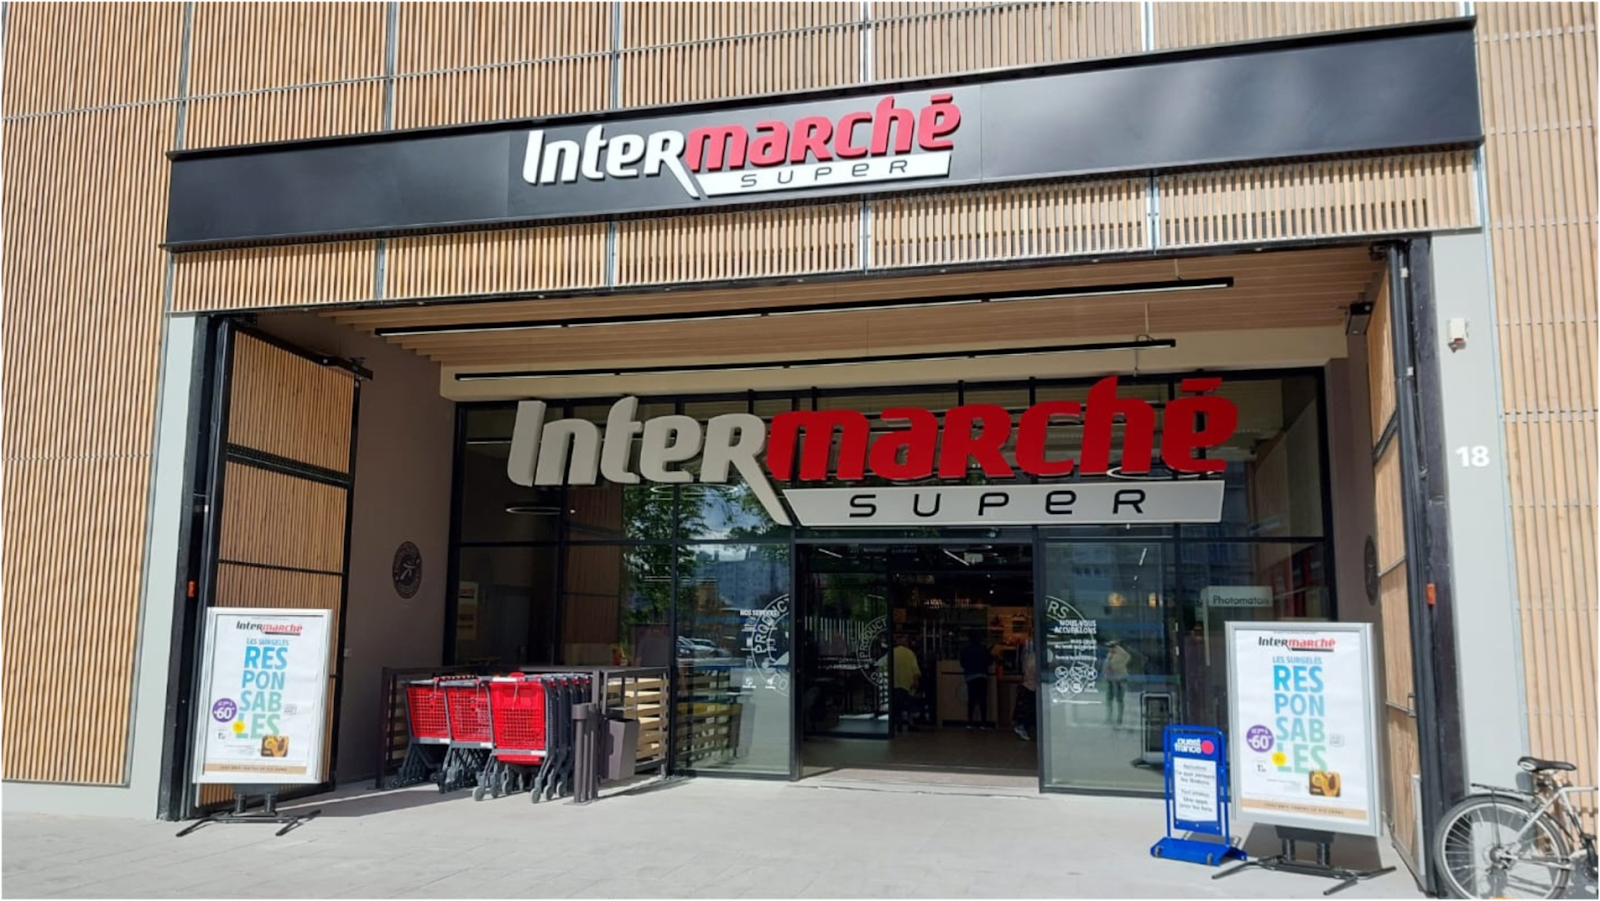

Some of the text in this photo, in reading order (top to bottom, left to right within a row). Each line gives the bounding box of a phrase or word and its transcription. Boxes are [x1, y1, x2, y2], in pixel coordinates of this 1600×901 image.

[522, 93, 961, 198] Intermarché
[740, 159, 909, 188] SUPER
[506, 376, 1239, 526] Intermarché
[1455, 445, 1490, 467] 18
[849, 488, 1147, 519] SUPER
[1212, 595, 1270, 605] Photomaton
[236, 620, 303, 634] Intermarché
[1258, 636, 1336, 651] Intermarché
[244, 646, 288, 670] RES
[1273, 656, 1285, 664] LES
[241, 670, 285, 690] PON
[1273, 665, 1324, 693] RES
[240, 690, 282, 713] SAB
[1274, 693, 1325, 717] PON
[235, 713, 281, 739] LES
[1276, 716, 1326, 743] SAB
[1276, 743, 1328, 775] LES
